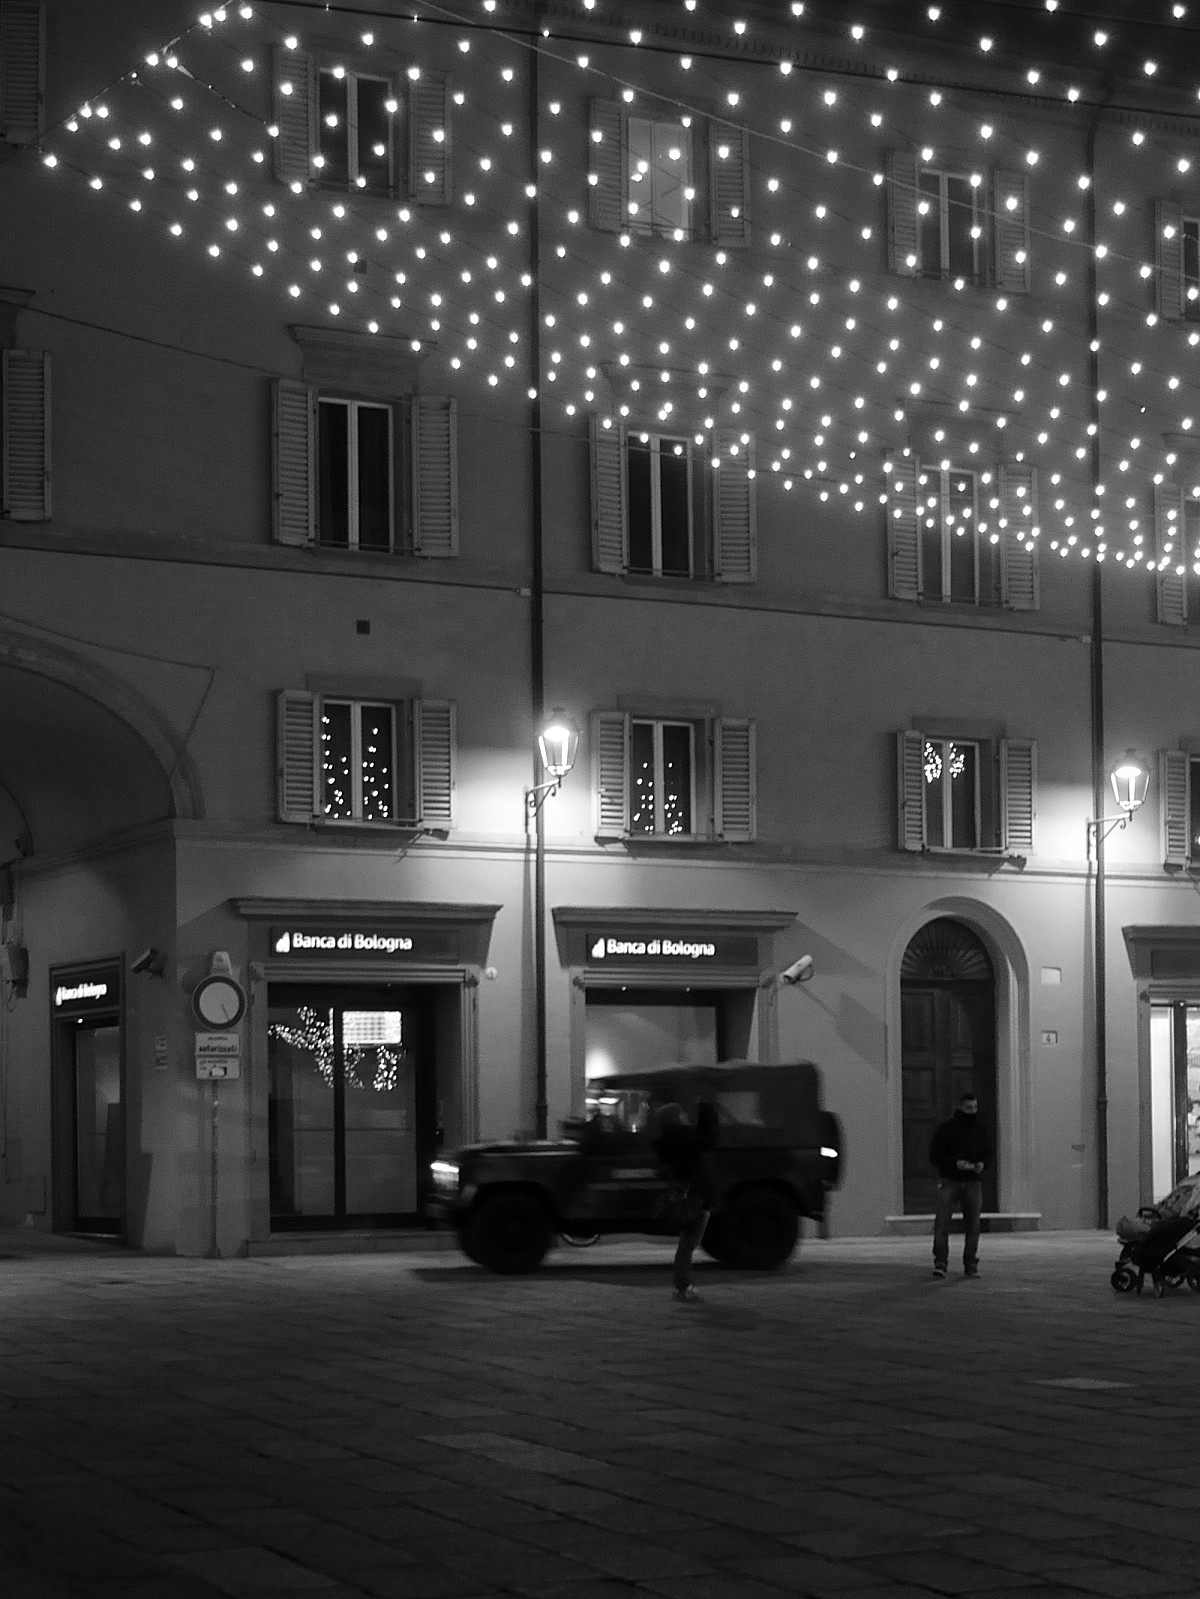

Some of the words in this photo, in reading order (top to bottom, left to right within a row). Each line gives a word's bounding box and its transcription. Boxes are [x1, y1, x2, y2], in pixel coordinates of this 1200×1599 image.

[292, 932, 336, 949] Banca
[337, 933, 352, 949] di
[354, 933, 412, 953] Bologna
[607, 938, 646, 954] Banca
[647, 939, 660, 955] di
[662, 939, 716, 958] Bologna
